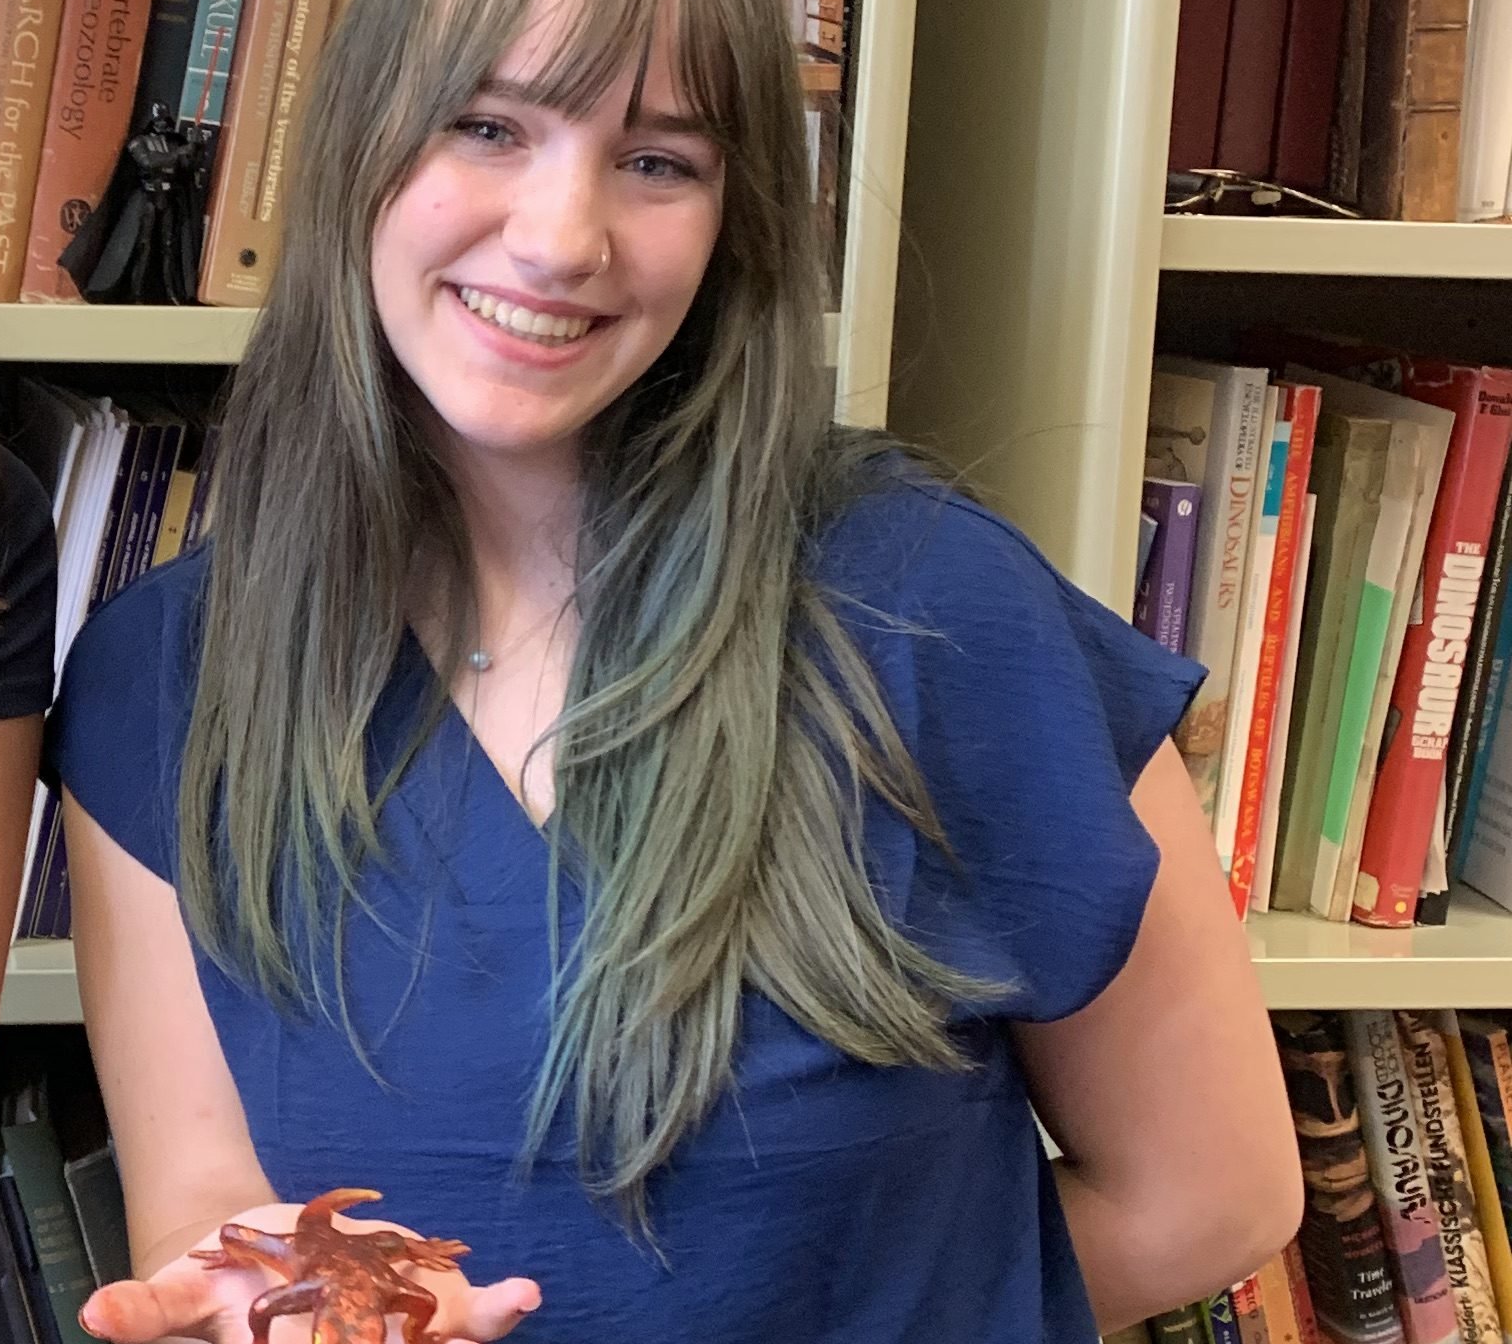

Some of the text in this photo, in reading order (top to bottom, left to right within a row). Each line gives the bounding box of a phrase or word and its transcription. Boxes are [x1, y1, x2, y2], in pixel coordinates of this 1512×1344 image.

[286, 58, 301, 82] of
[3, 94, 30, 133] for
[279, 81, 298, 114] the
[1215, 475, 1253, 610] DINOSAURS
[1455, 541, 1482, 556] THE
[1412, 552, 1486, 738] DINOSAUR
